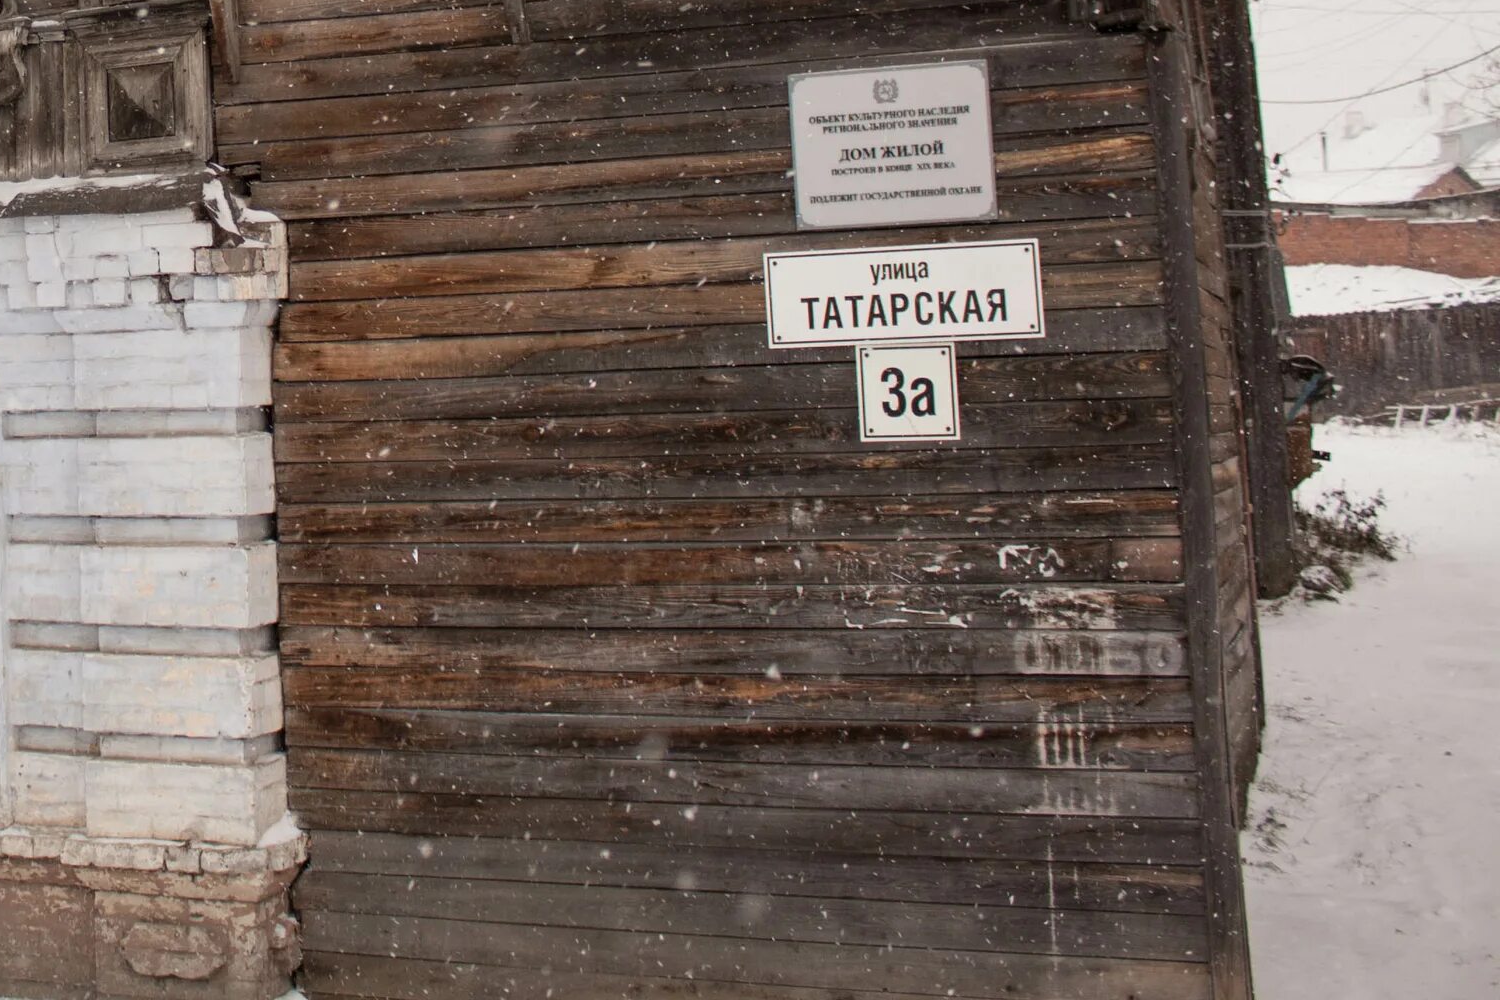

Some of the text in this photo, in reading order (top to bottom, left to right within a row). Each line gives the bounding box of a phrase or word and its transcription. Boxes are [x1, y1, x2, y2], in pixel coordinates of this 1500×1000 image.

[809, 105, 970, 124] ОБЪЕКТ КУЛЬТУРНОГО НАСЛЕДИЯ
[823, 117, 957, 134] РЕГИОНАЛЬНОГО ЗНАЧЕНИЯ
[839, 140, 944, 162] ДОМ ЖИЛОЙ
[832, 166, 875, 176] ПОСТРОЕН
[886, 164, 913, 172] КОНЦЕ
[934, 161, 955, 169] ВЕКА
[810, 186, 983, 204] ПОДЛЕЖИТ ГОСУДАРСТВЕННОЙ ОХРАНЕ
[870, 260, 929, 285] улица
[801, 289, 1007, 330] ТАТАРСКАЯ
[880, 367, 937, 417] 3а
